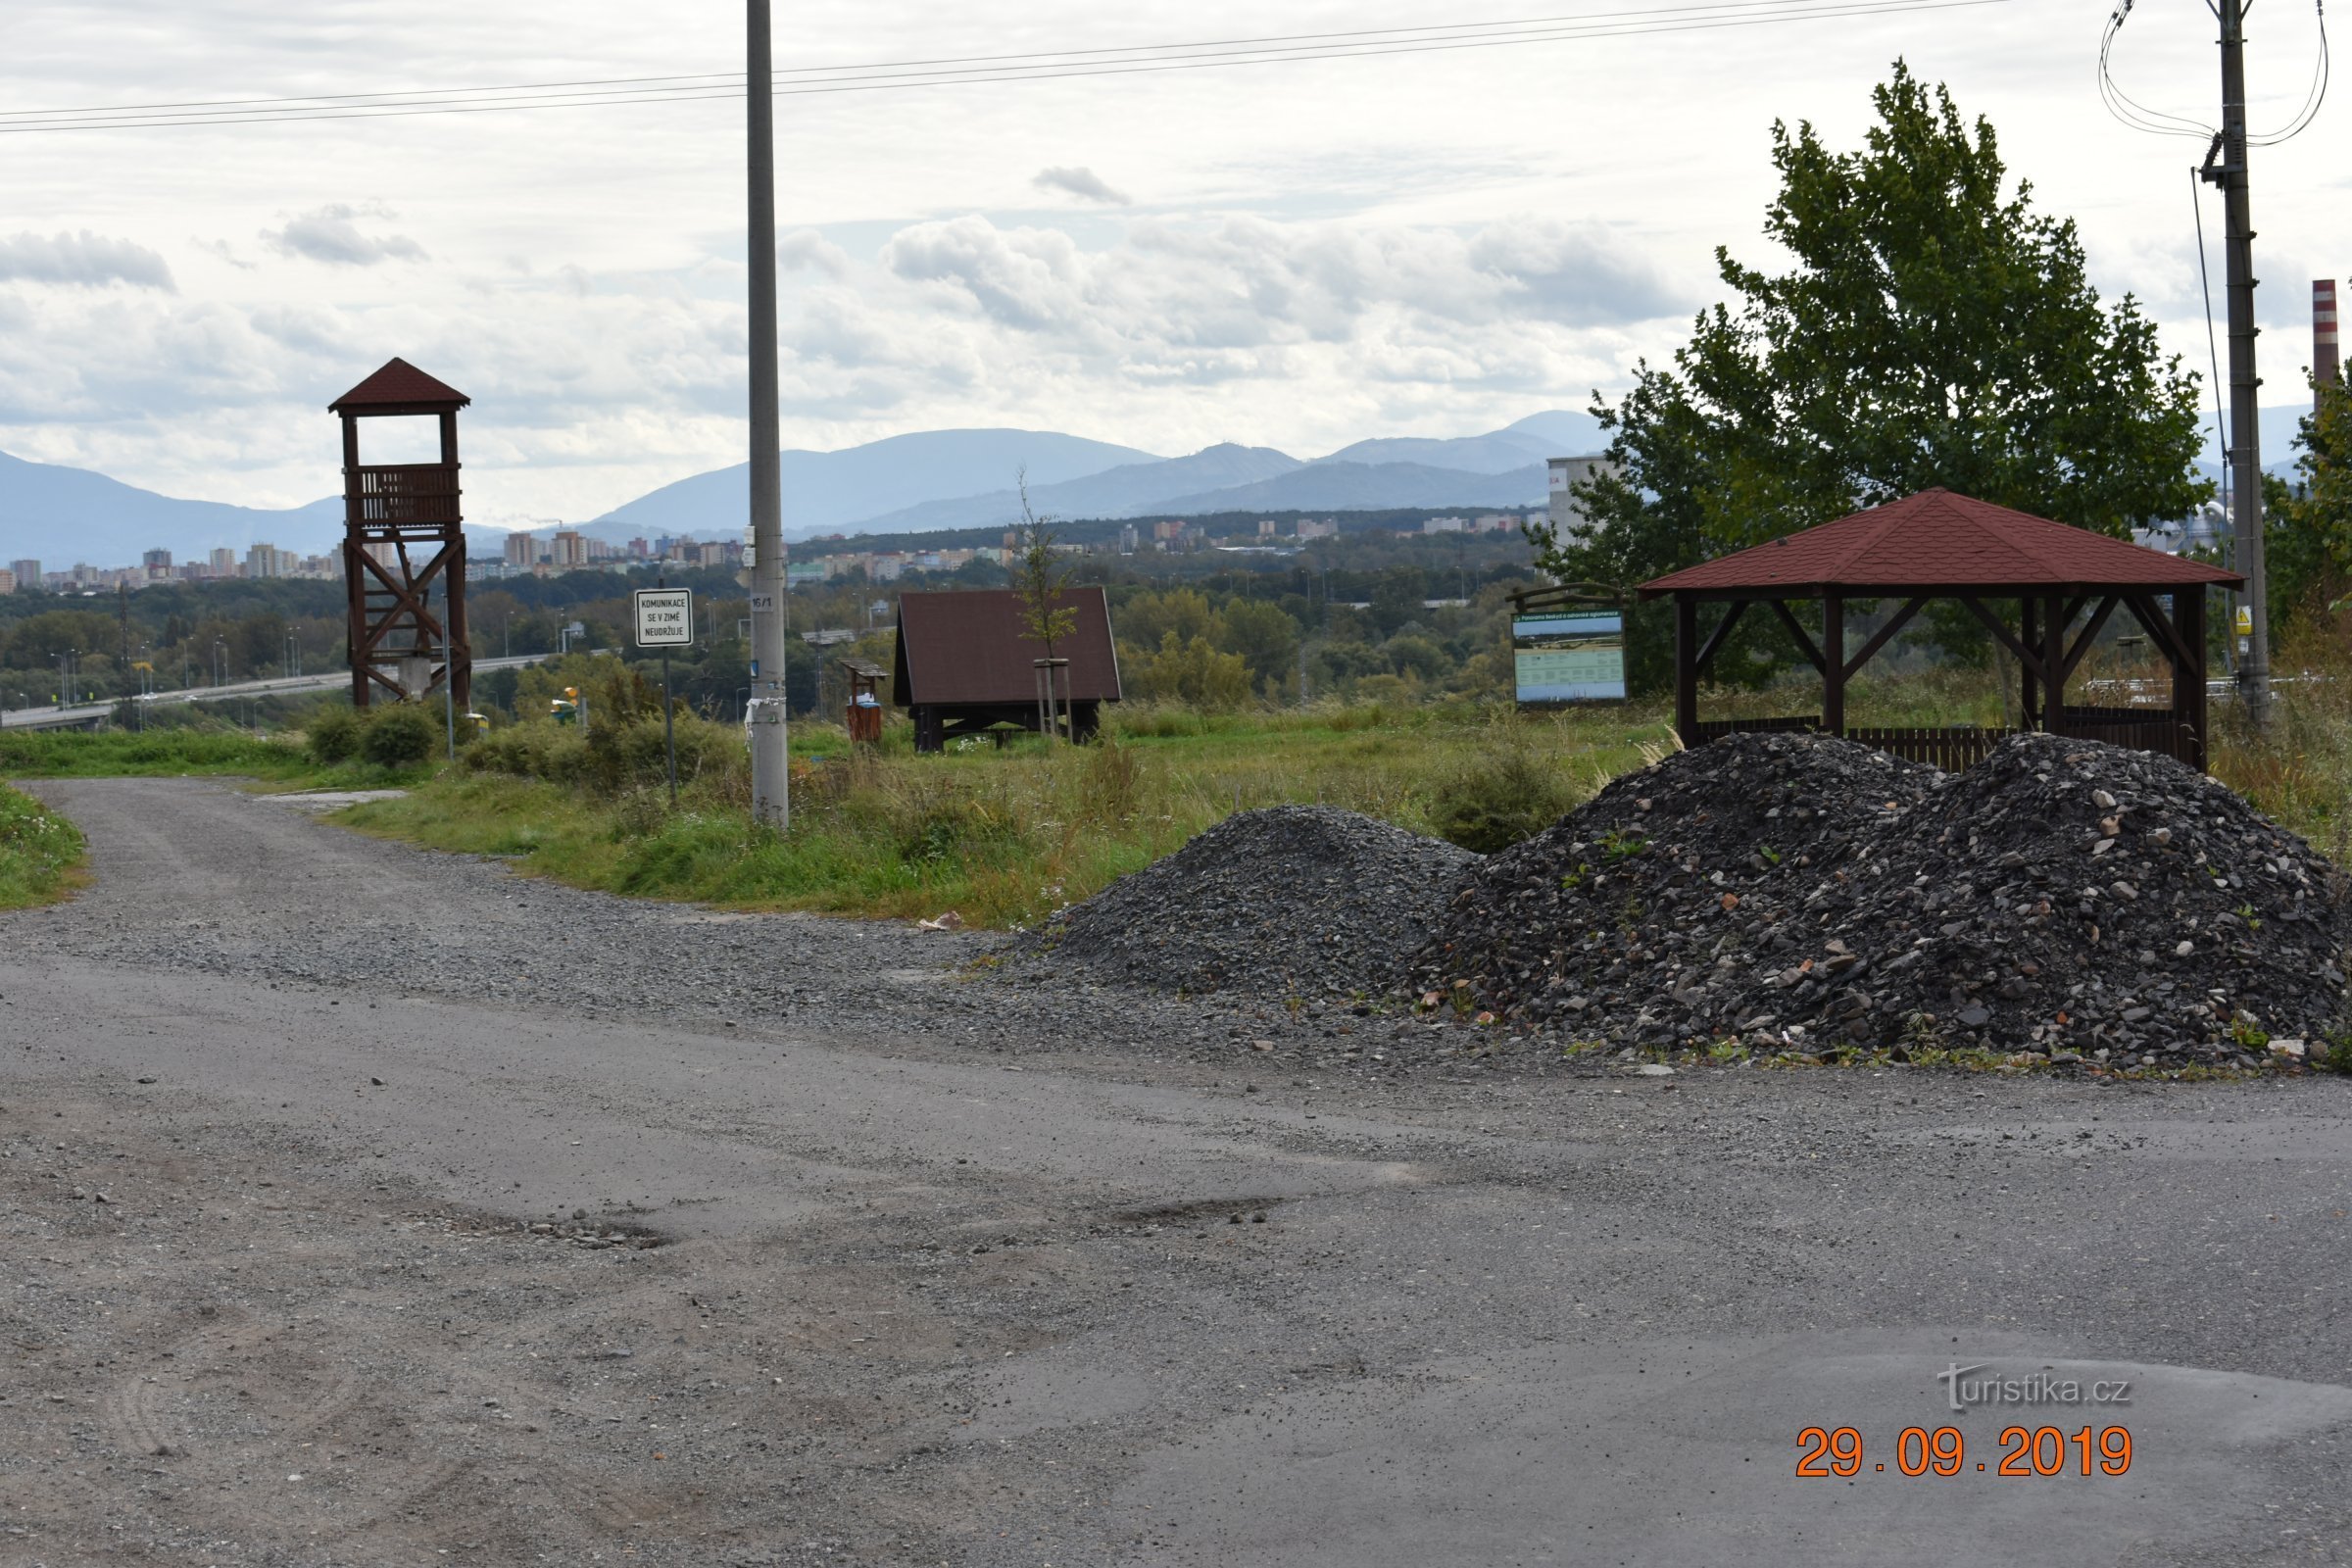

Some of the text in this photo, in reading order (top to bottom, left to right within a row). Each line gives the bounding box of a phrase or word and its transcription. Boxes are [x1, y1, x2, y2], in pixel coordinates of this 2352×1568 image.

[641, 599, 686, 609] KOMUNIKACE
[753, 597, 771, 608] 16/1
[648, 611, 680, 622] SE V ZIMĚ
[645, 625, 684, 637] NEUDRŽUJE
